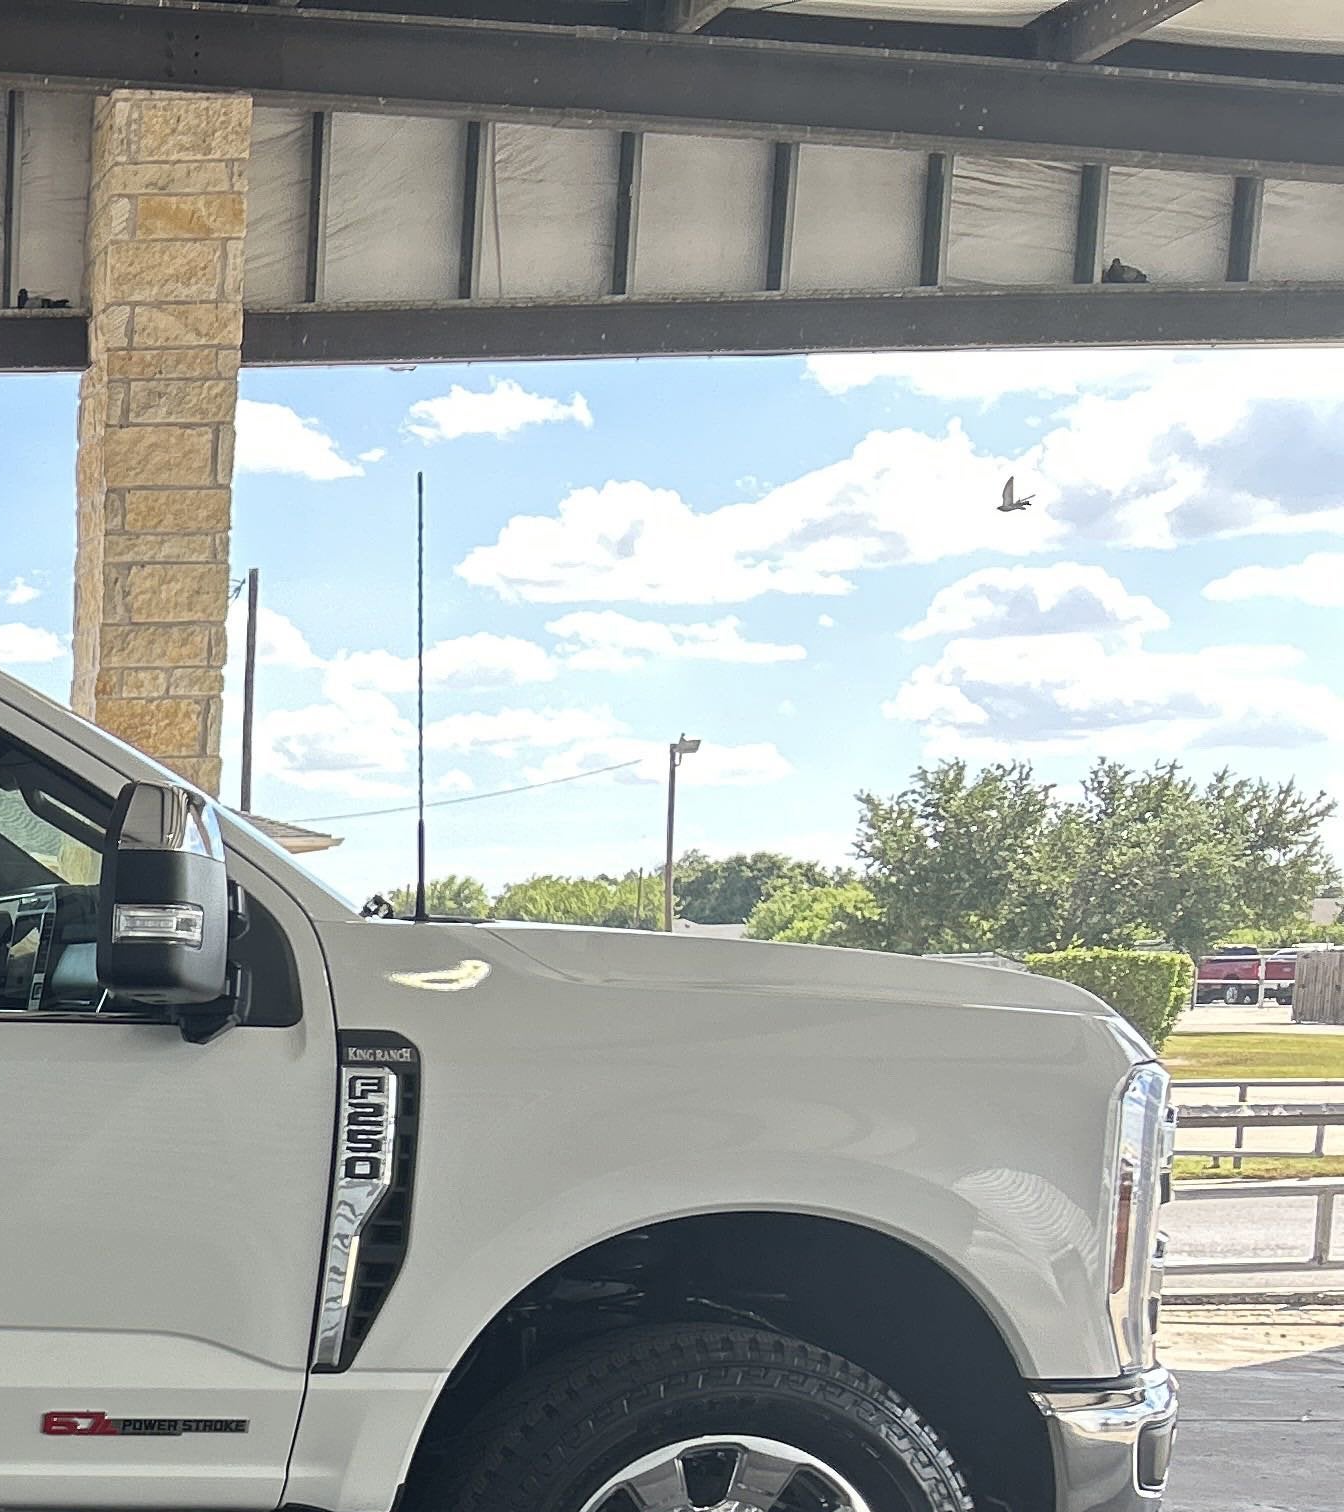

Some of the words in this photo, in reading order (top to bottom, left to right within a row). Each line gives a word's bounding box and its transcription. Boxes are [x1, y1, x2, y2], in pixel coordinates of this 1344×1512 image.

[348, 1047, 374, 1061] KING
[375, 1048, 411, 1062] RANCH
[121, 1419, 177, 1432] POWER
[181, 1419, 247, 1433] STROKE
